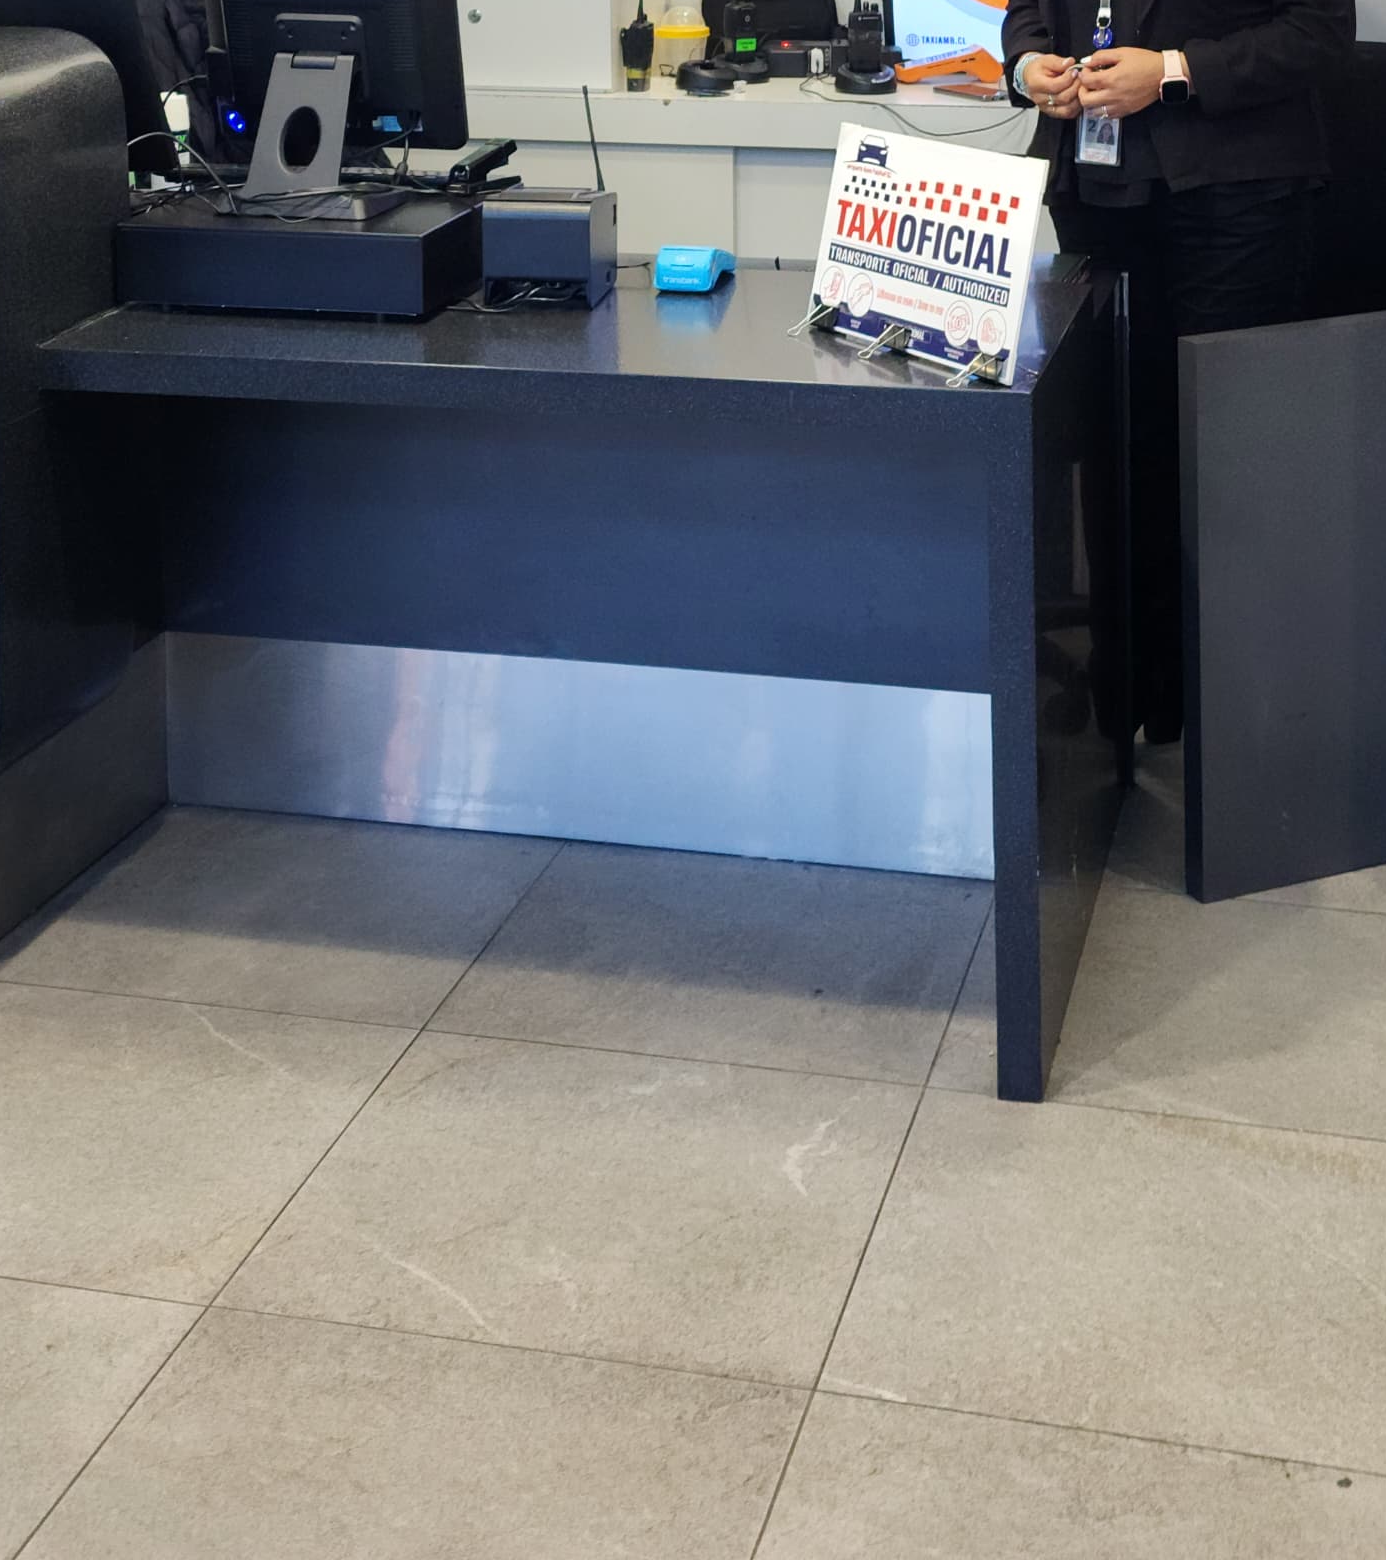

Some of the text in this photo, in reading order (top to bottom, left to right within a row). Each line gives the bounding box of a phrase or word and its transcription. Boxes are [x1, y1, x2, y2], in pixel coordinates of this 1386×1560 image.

[829, 244, 891, 273] TRANSPORTE
[892, 261, 930, 285] OFICIAL
[941, 274, 1009, 305] AUTHORIZED
